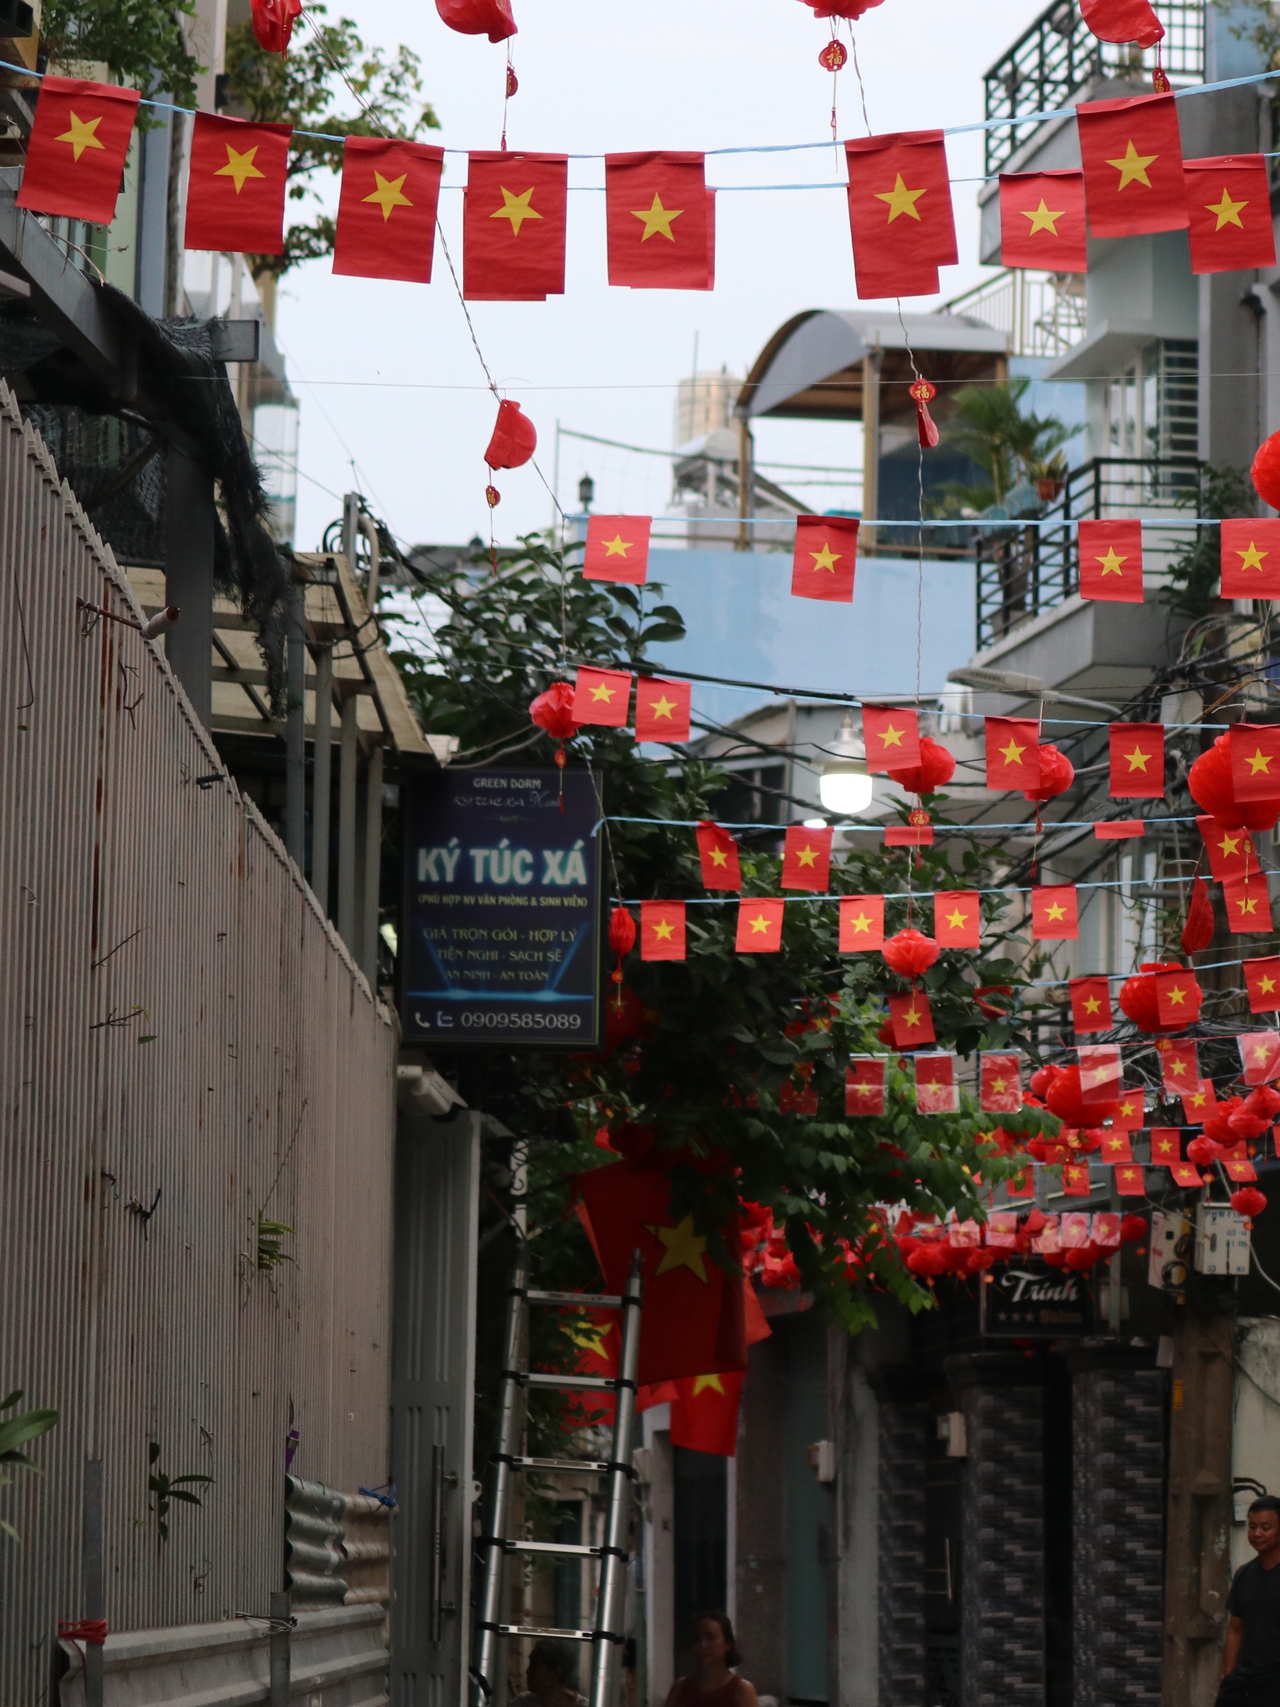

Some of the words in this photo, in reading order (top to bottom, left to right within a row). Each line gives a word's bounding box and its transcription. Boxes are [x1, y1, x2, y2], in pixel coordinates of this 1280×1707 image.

[827, 45, 843, 66] 福
[915, 384, 931, 400] 福
[473, 778, 507, 789] GREEN
[510, 778, 542, 789] DORM
[417, 837, 461, 883] KÝ
[469, 837, 534, 885] TÚC
[541, 839, 588, 885] XÁ
[463, 895, 476, 905] NV
[498, 893, 529, 906] PHÒNG
[530, 896, 538, 906] &
[539, 896, 562, 907] SINH
[563, 894, 588, 908] VIÊN)
[423, 926, 447, 940] GIÁ
[451, 928, 488, 942] TRỌN
[491, 927, 518, 941] GÓI
[529, 928, 558, 944] HỢP
[437, 946, 463, 962] TIỆN
[467, 949, 499, 961] NGHI
[509, 950, 543, 963] SẠCH
[463, 970, 491, 980] NINH
[500, 970, 515, 981] AN
[518, 969, 549, 981] TOÀN
[460, 1012, 582, 1029] 0909585089
[1001, 1270, 1081, 1303] Trinh
